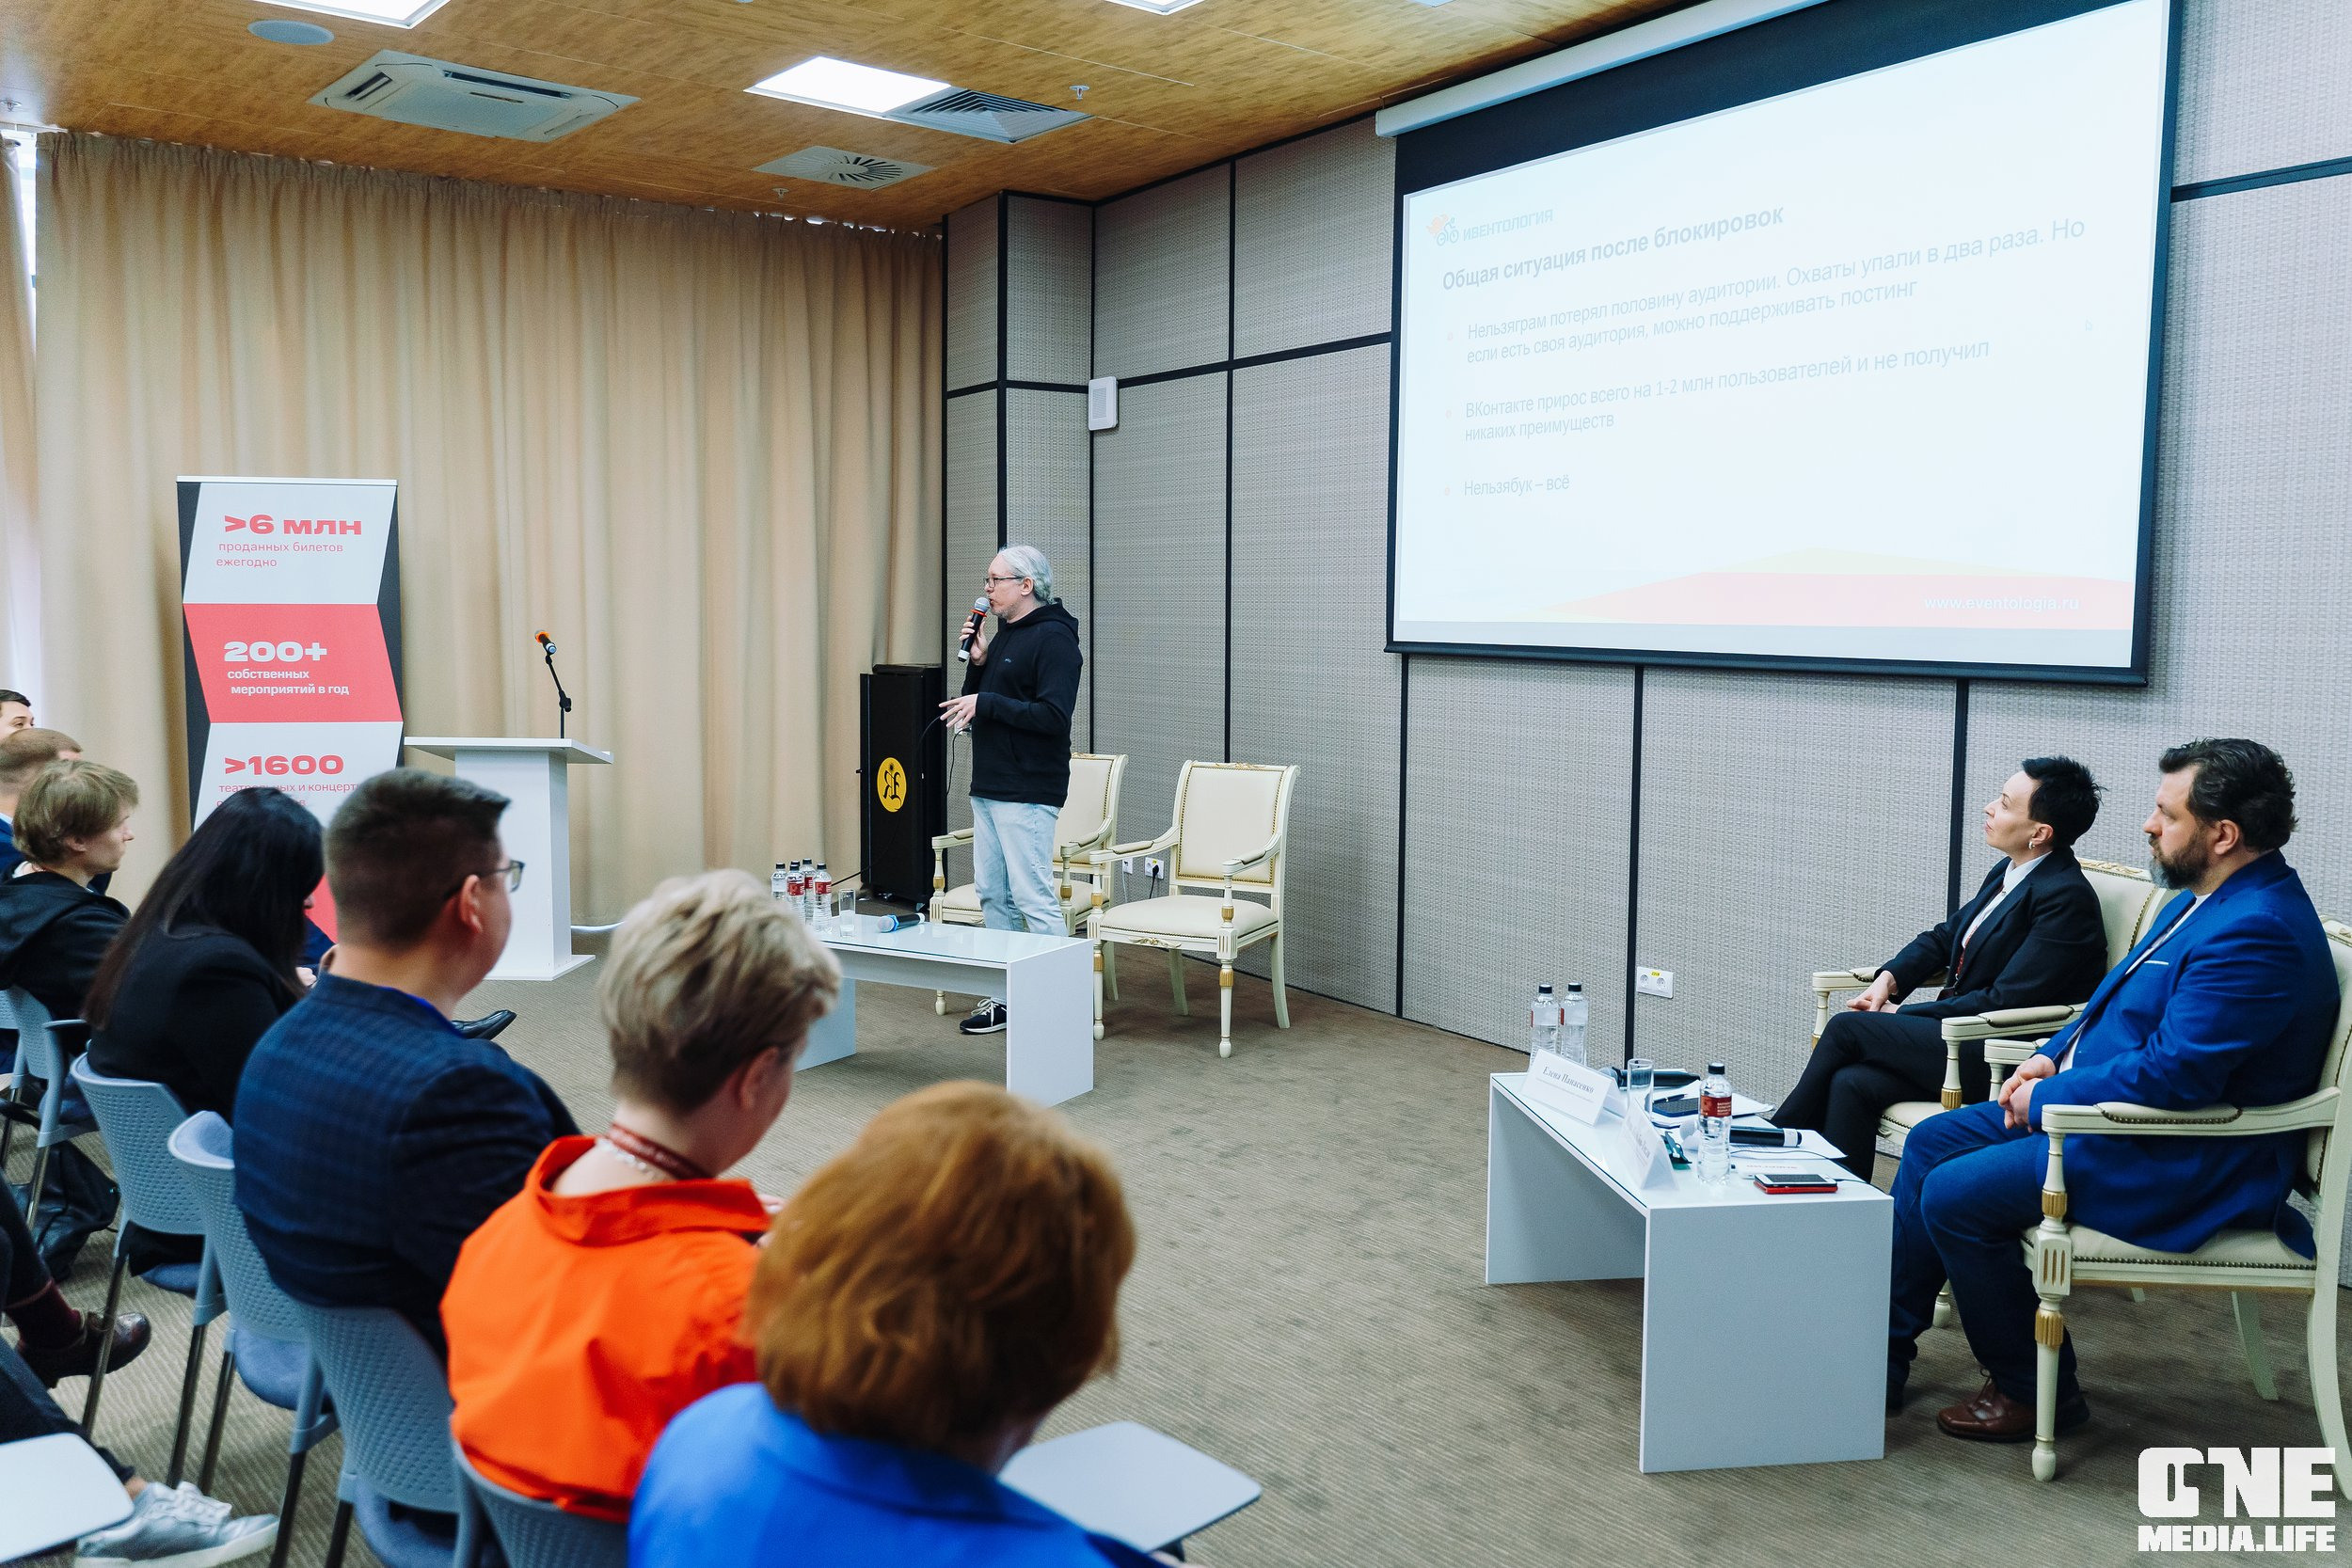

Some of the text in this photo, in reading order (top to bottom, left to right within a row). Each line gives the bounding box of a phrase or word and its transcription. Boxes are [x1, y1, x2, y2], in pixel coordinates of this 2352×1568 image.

[1463, 209, 1553, 242] ИВЕНТОЛОГИЯ
[1443, 206, 1784, 291] Общая ситуация после блокировок
[1468, 218, 2085, 340] Нельзяграм потерял половину аудитории. Охваты упали в два раза. Но
[1467, 278, 1917, 363] если есть своя аудитория, можно поддерживать постинг
[1466, 341, 1990, 419] ВКонтакте прирос всего на 1-2 млн пользователей и не получил
[1465, 411, 1614, 442] никаких преимуществ
[1464, 478, 1533, 497] Нельзябук
[1546, 473, 1570, 491] всё
[224, 514, 361, 535] >6 млн
[218, 541, 343, 554] проданных билетов
[215, 557, 278, 568] ежегодно
[1925, 596, 2079, 612] www.eventologia.ru
[223, 641, 327, 662] 200+
[227, 668, 310, 679] собственных
[230, 684, 349, 696] мероприятий в год
[224, 754, 344, 776] >1600
[219, 784, 295, 793] театых
